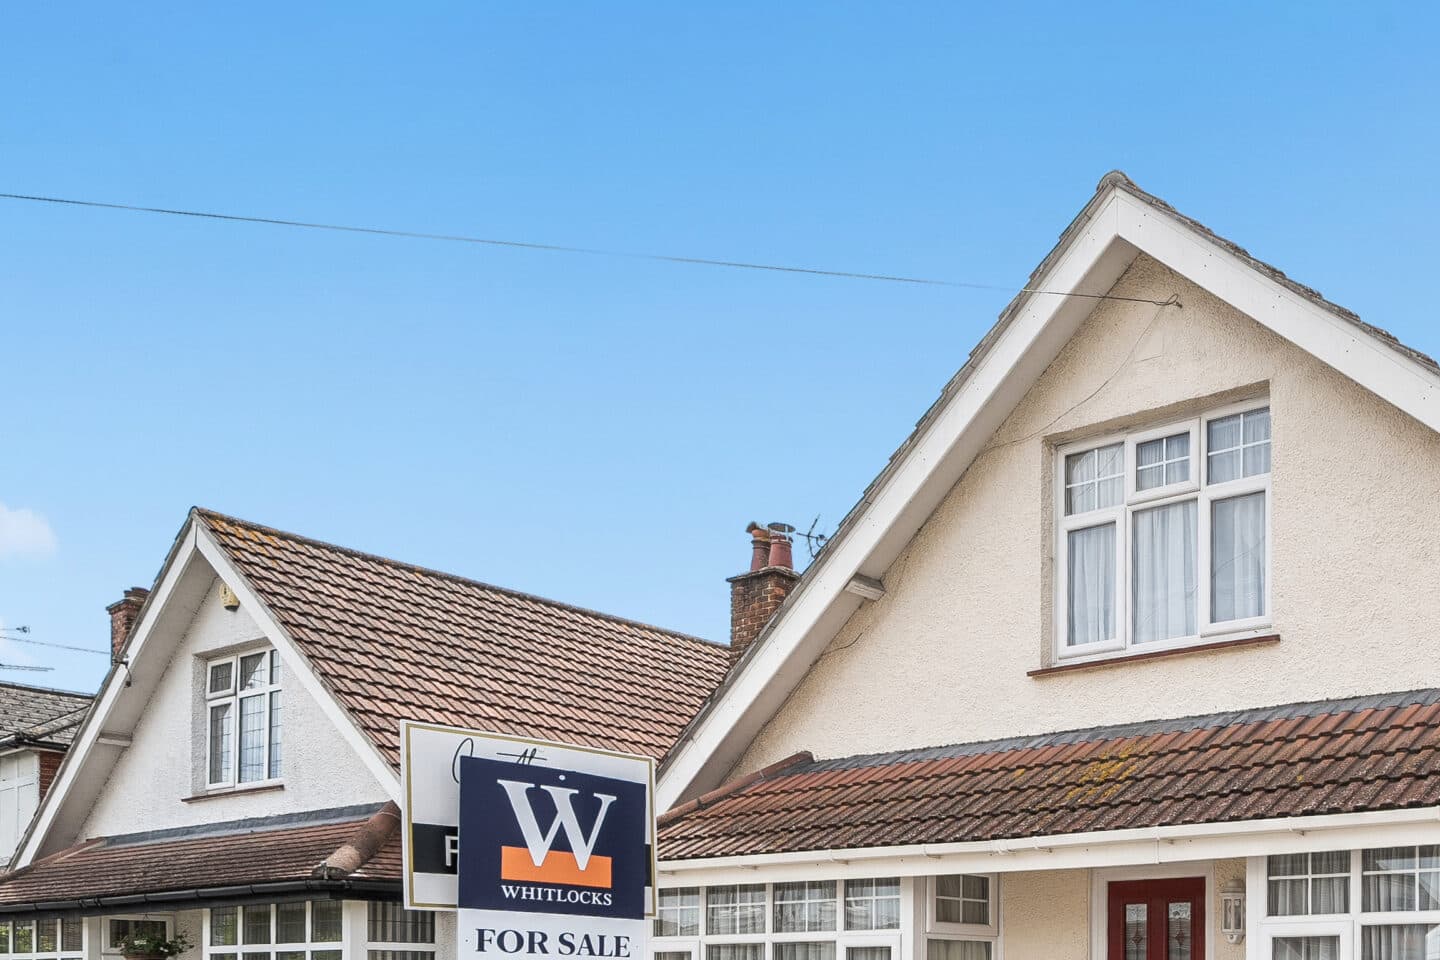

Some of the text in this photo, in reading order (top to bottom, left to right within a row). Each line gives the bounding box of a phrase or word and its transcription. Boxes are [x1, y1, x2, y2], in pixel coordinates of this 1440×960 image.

[497, 779, 617, 871] W
[501, 885, 612, 906] WHITLOCKS
[475, 928, 631, 958] FOR SALE
